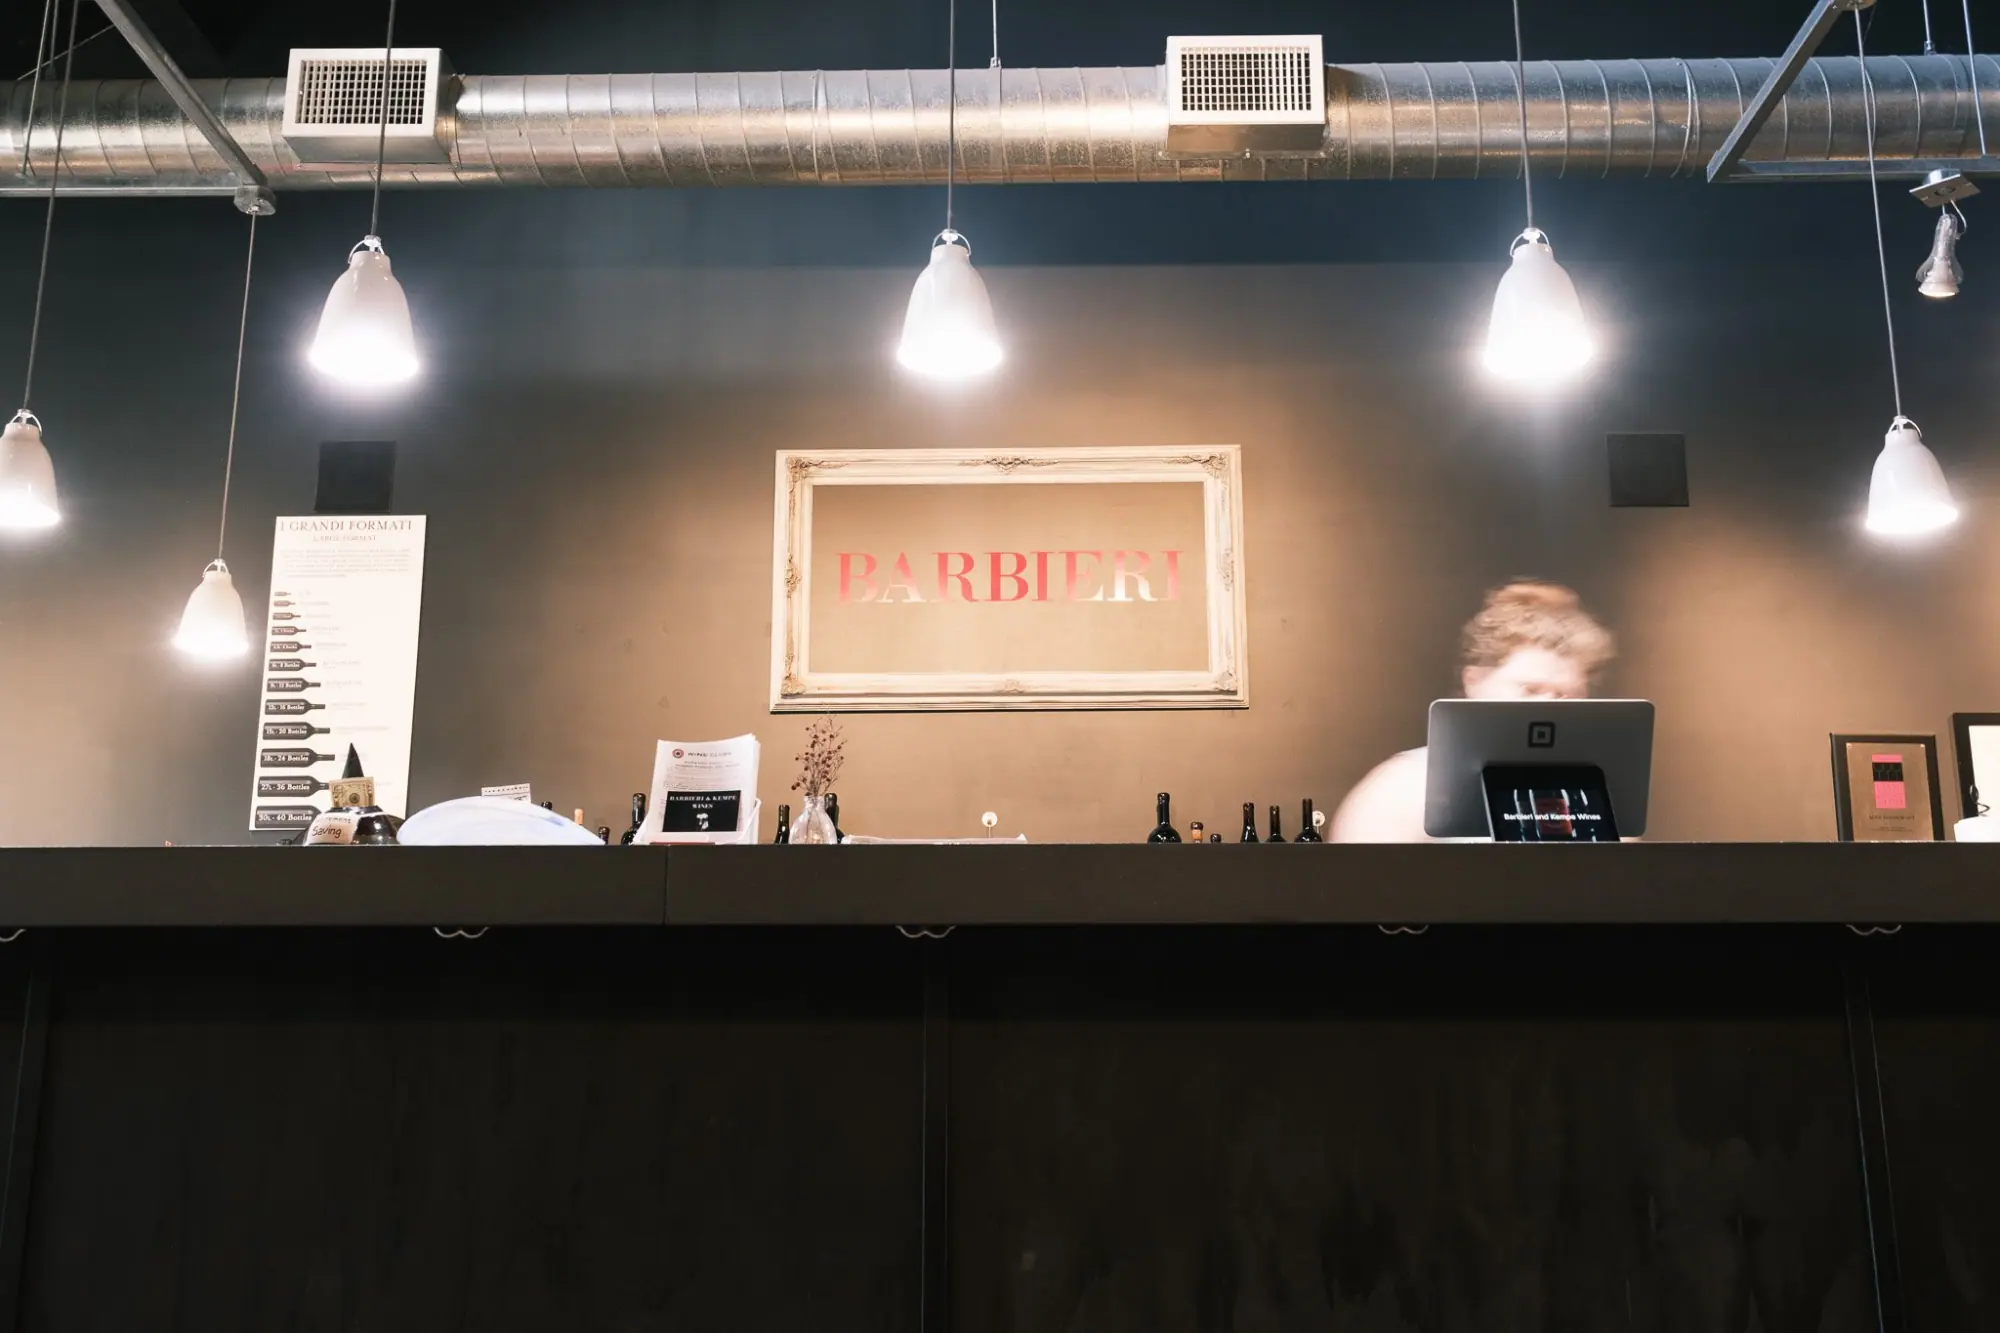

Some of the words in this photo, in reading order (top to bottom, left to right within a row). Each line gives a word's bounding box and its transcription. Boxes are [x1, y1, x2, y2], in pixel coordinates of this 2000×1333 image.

[289, 520, 344, 531] GRANDI
[349, 520, 412, 531] FORMATI
[834, 550, 1185, 603] BARBIERI
[1550, 813, 1576, 821] Kempe
[311, 825, 342, 839] Saving
